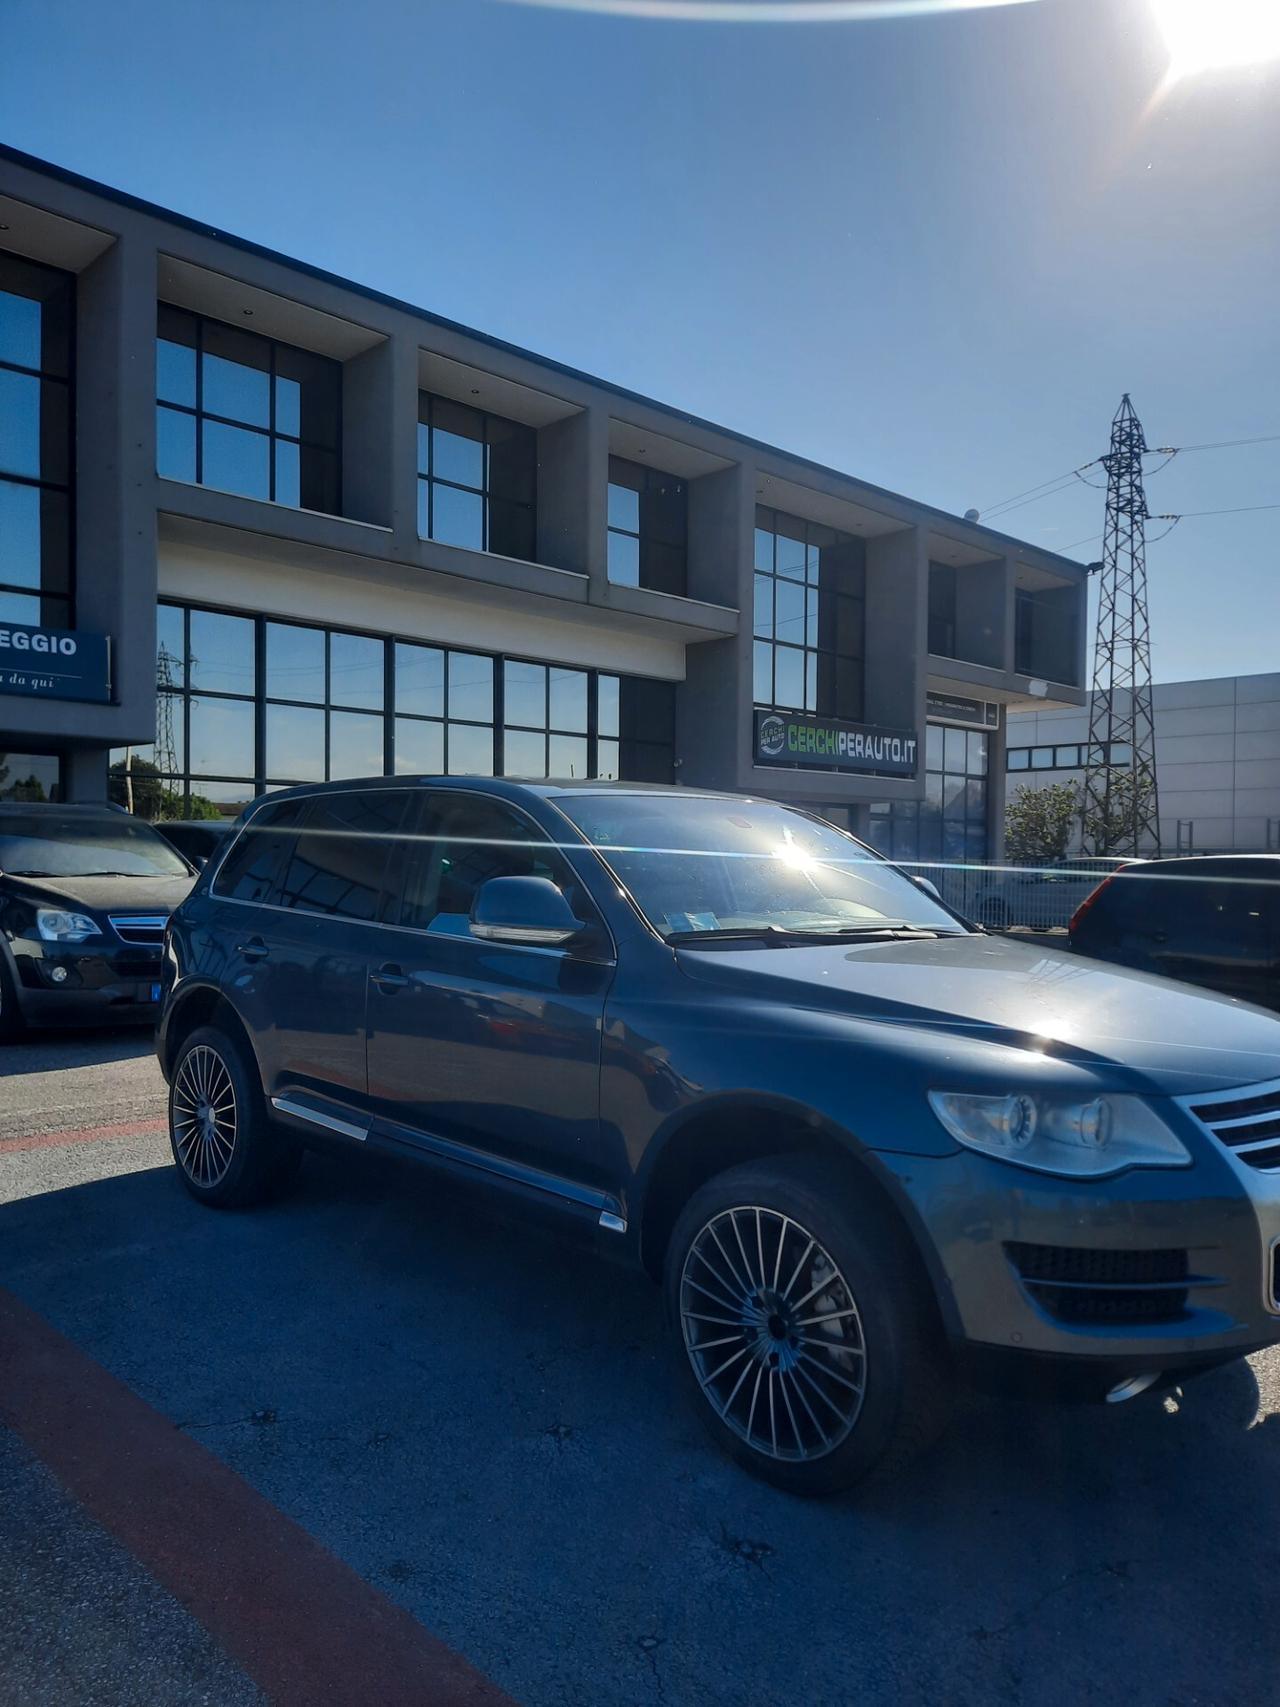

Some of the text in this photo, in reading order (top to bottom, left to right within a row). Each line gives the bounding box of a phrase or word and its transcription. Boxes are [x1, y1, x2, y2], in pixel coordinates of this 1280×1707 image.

[0, 629, 77, 656] EGGIO
[9, 673, 26, 685] da
[788, 724, 916, 764] CERCHIPERAUTO.IT
